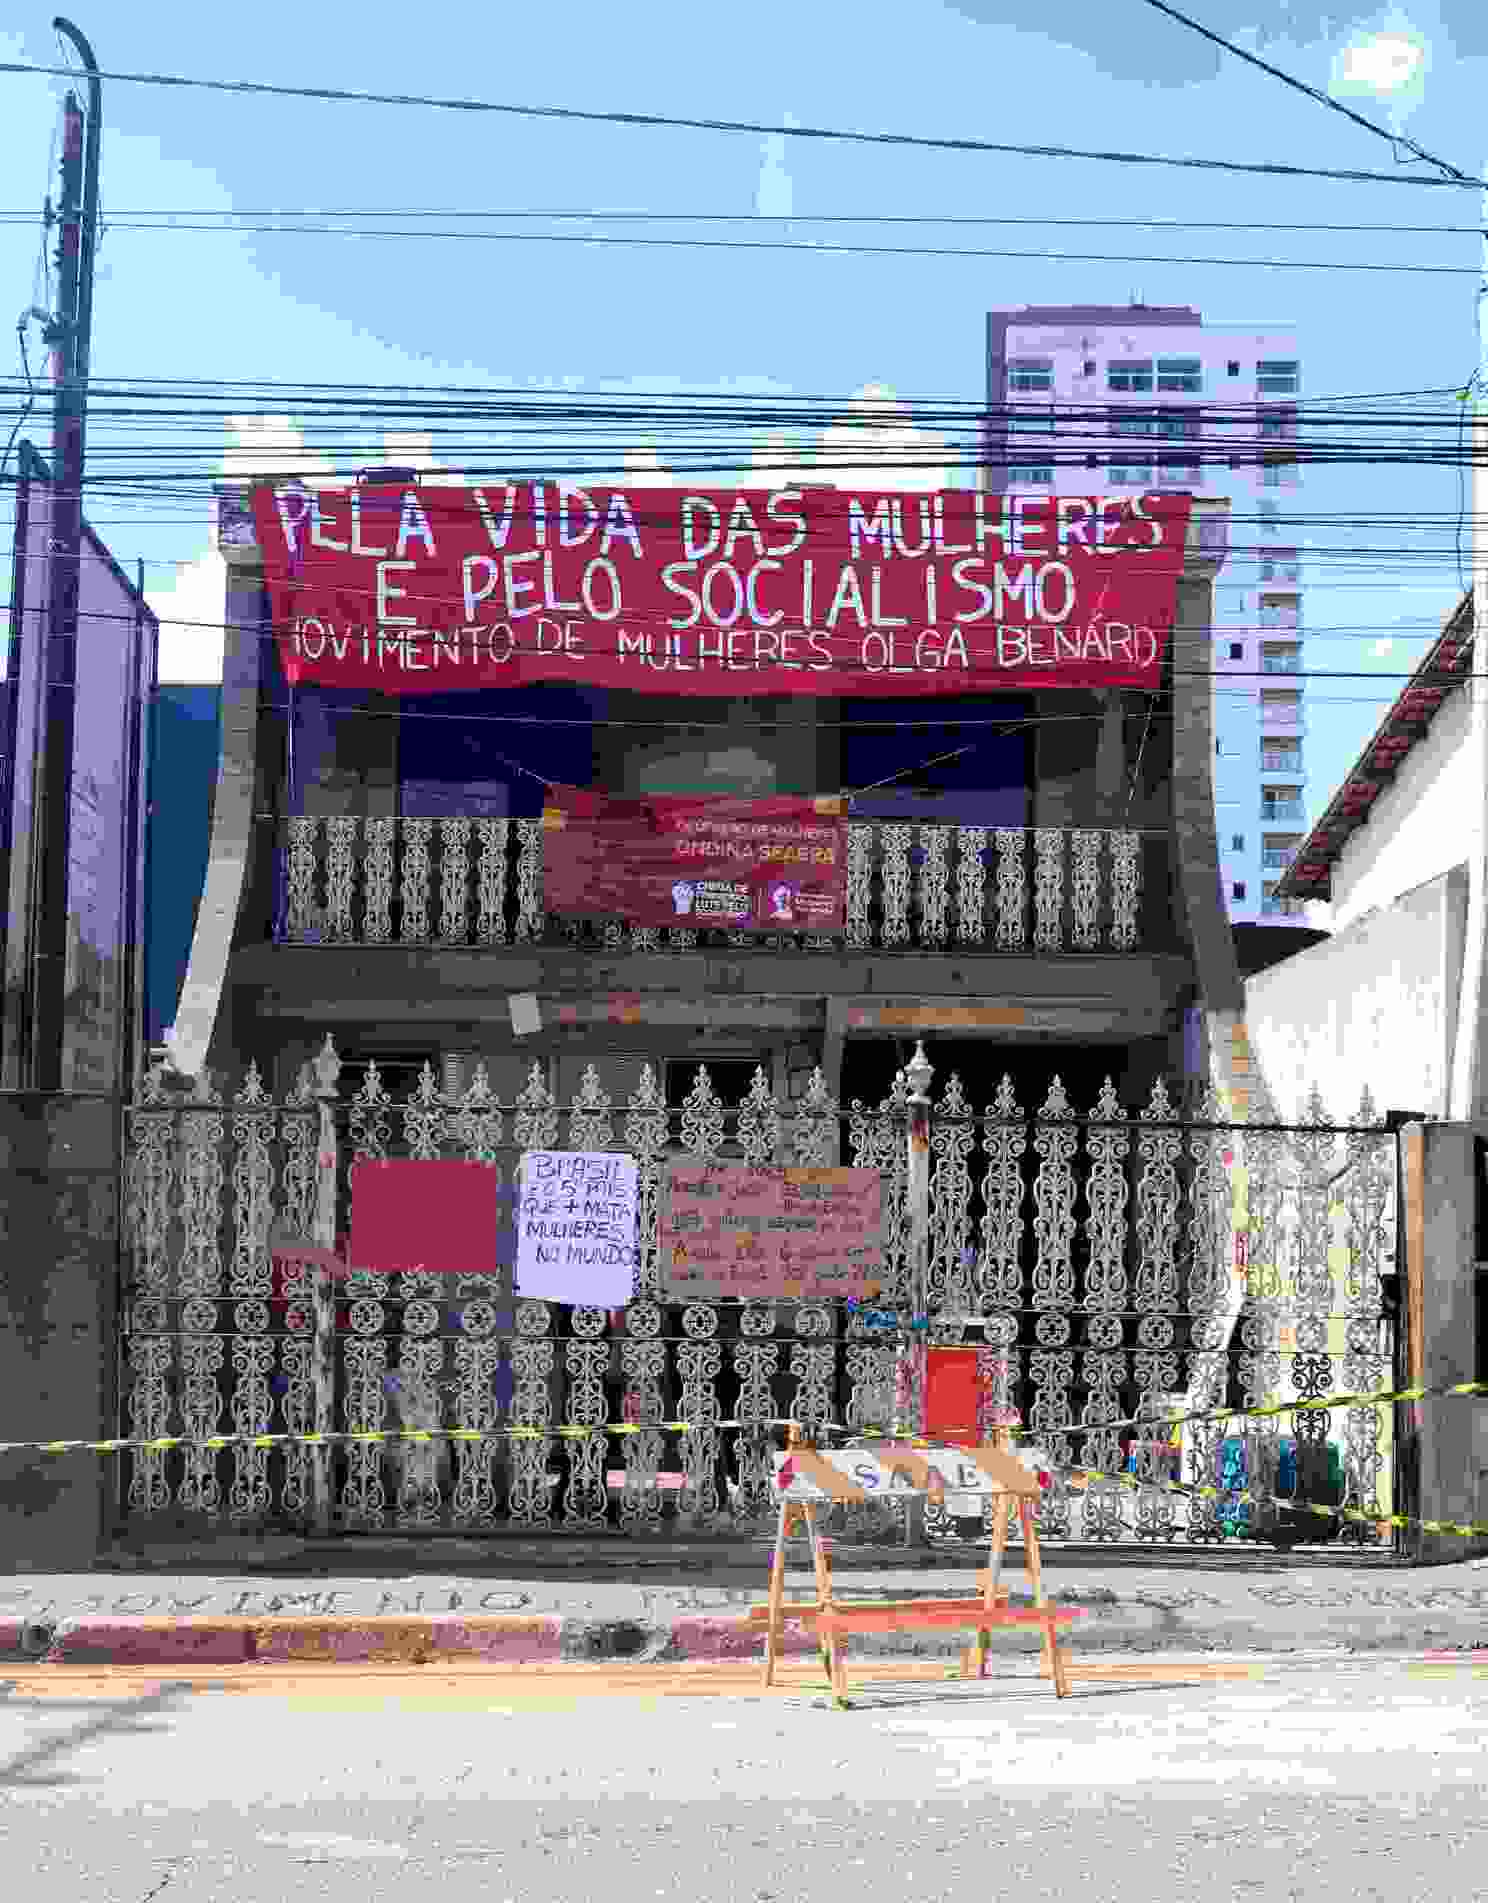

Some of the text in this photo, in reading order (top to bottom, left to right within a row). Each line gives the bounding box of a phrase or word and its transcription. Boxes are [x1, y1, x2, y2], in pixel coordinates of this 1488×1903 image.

[275, 481, 1162, 558] PELA VIDA DAS MULHERES
[376, 550, 1076, 629] E PELO SOCIALISMO
[537, 619, 586, 661] DE
[616, 626, 834, 672] MULHERES
[862, 624, 969, 673] OLGA
[526, 1220, 626, 1242] MULHERES
